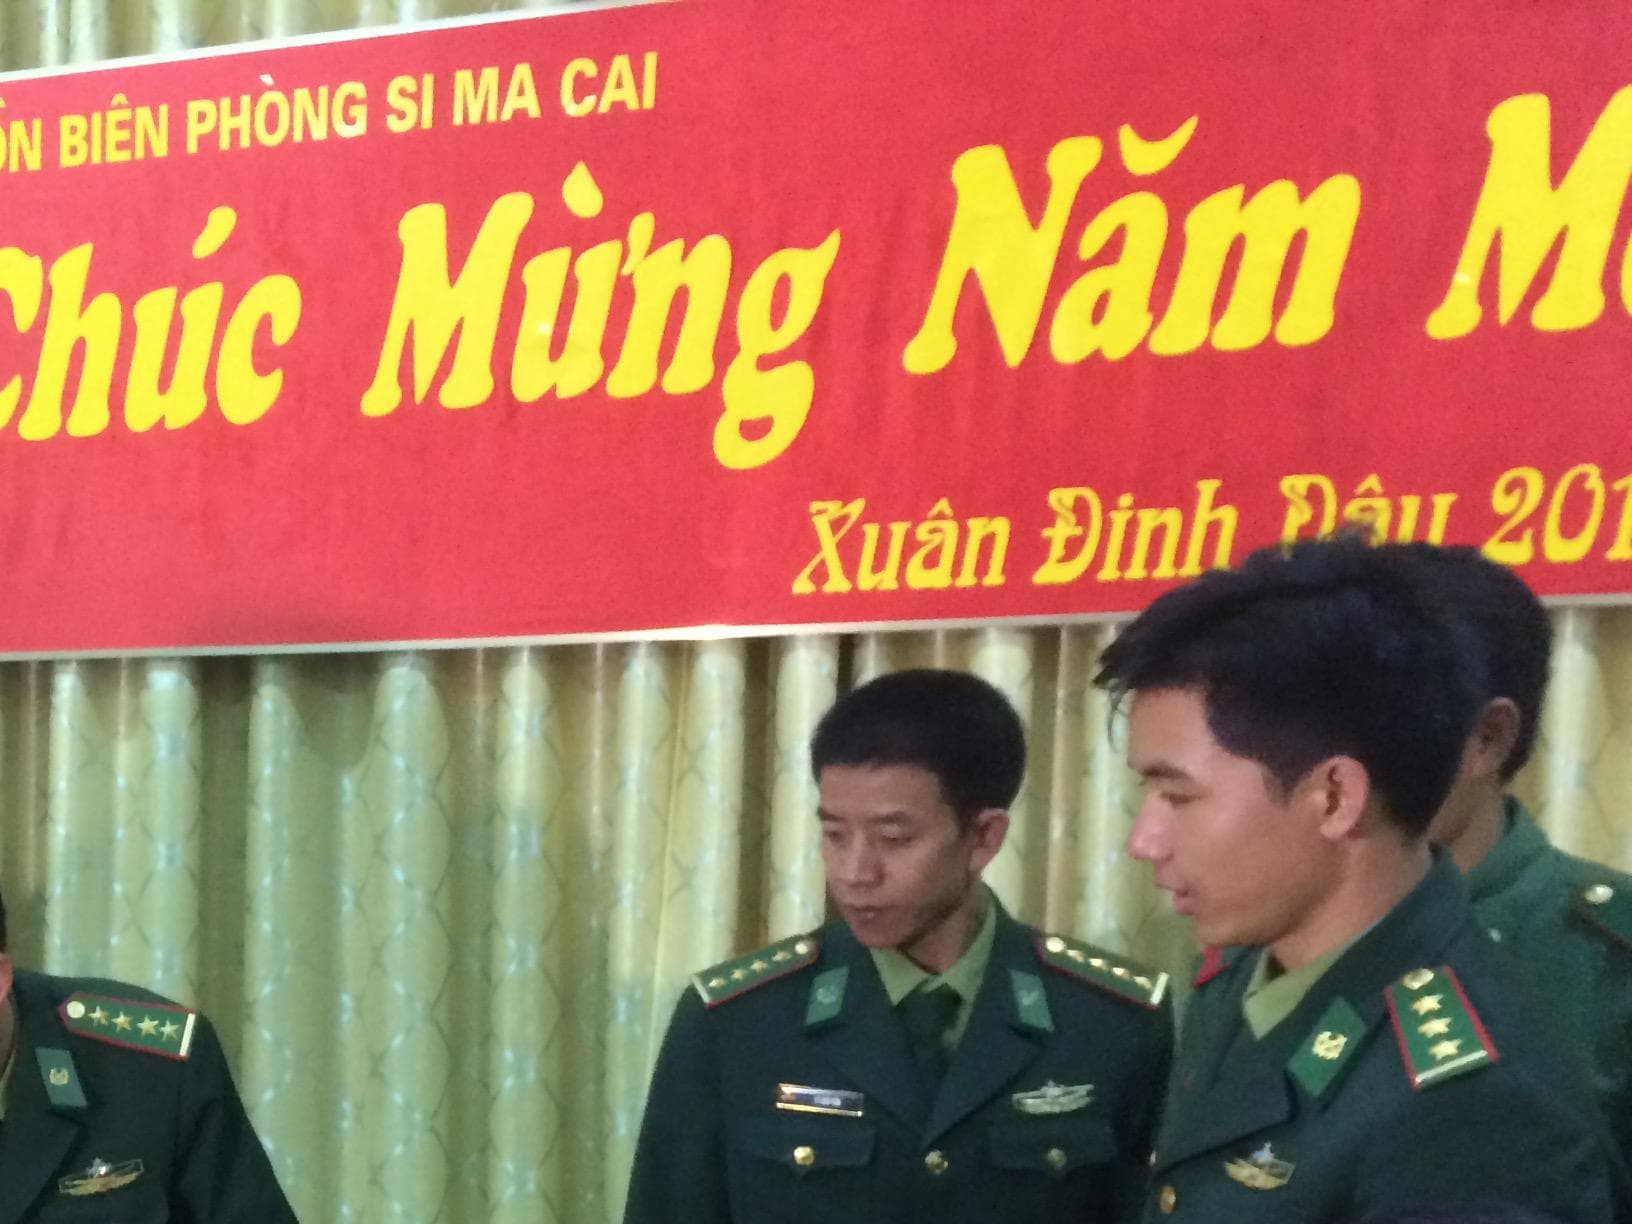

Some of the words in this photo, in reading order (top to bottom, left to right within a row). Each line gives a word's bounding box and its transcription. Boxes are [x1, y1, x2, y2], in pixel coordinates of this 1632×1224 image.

[59, 93, 169, 168] BIÊN
[186, 74, 368, 154] PHÒNG
[386, 73, 434, 133] SI
[453, 63, 541, 126] MA
[560, 52, 658, 117] CAI
[360, 161, 841, 470] Mừng
[903, 115, 1361, 375] Năm
[1425, 83, 1632, 340] M
[792, 498, 1011, 595] Xuân
[1032, 479, 1238, 585] Đinh
